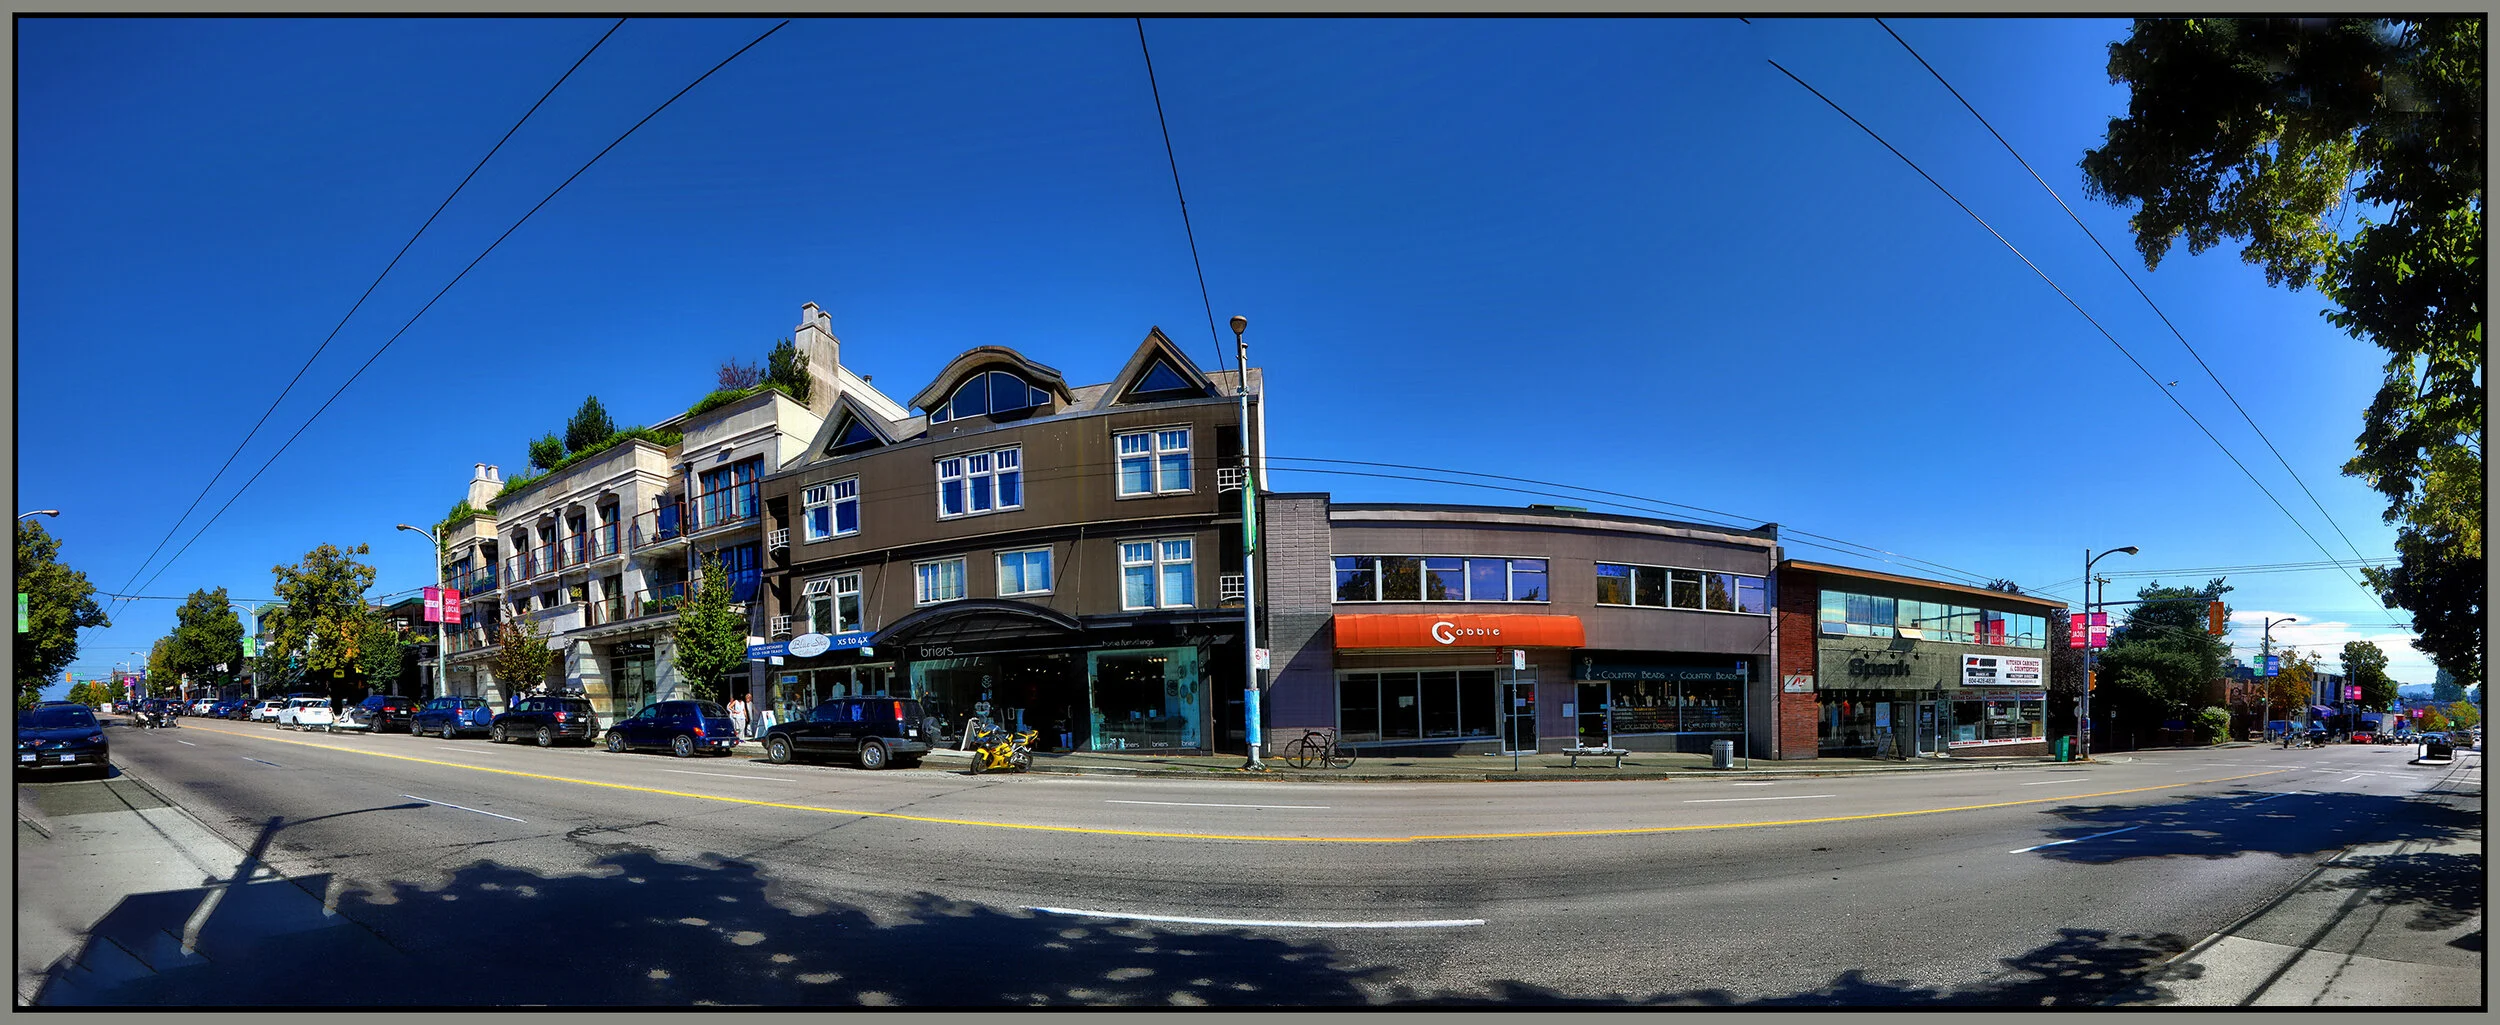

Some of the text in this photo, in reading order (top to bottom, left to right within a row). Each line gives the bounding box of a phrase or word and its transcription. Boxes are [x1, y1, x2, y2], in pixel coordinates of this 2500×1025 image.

[445, 605, 459, 613] LOCAL
[1431, 621, 1500, 645] Gobble
[791, 636, 827, 650] Blue Sky
[848, 636, 857, 645] to
[920, 645, 954, 658] briers
[1601, 670, 1666, 679] COUNTRY BEADS
[1848, 658, 1911, 681] Spank
[1679, 671, 1738, 680] COUNTRY BEADS
